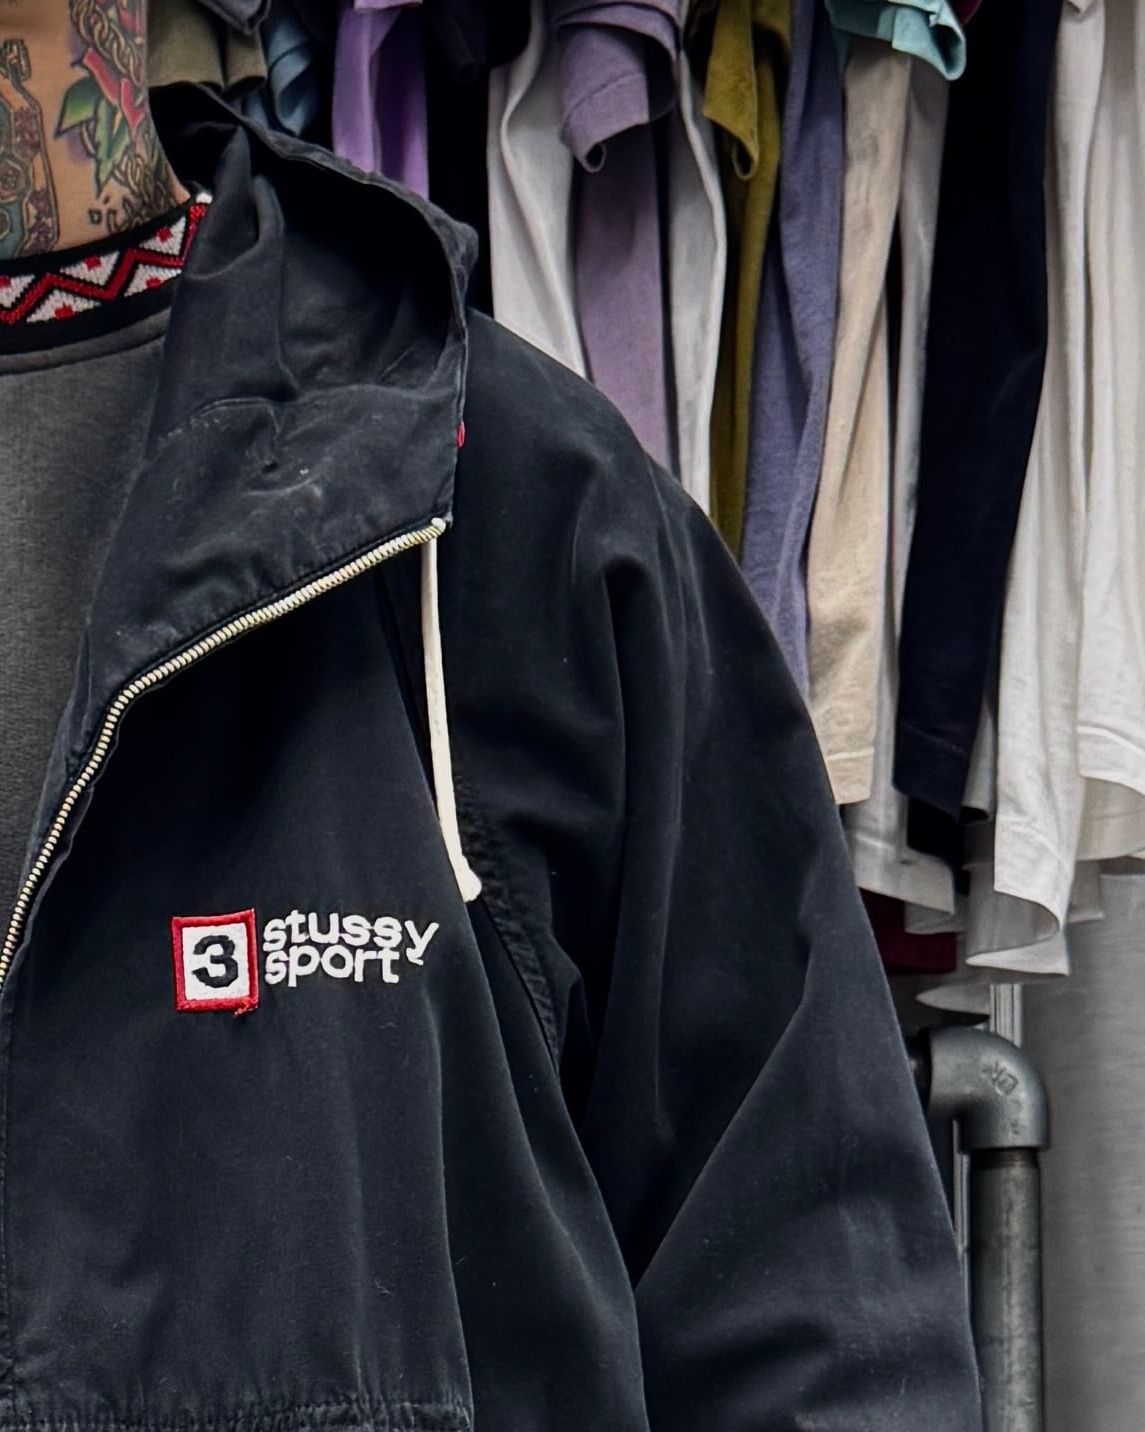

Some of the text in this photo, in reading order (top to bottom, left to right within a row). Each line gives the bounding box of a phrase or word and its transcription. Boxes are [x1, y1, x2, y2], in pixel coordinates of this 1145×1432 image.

[191, 935, 239, 989] 3
[263, 909, 440, 966] stussy
[264, 944, 400, 987] sport
